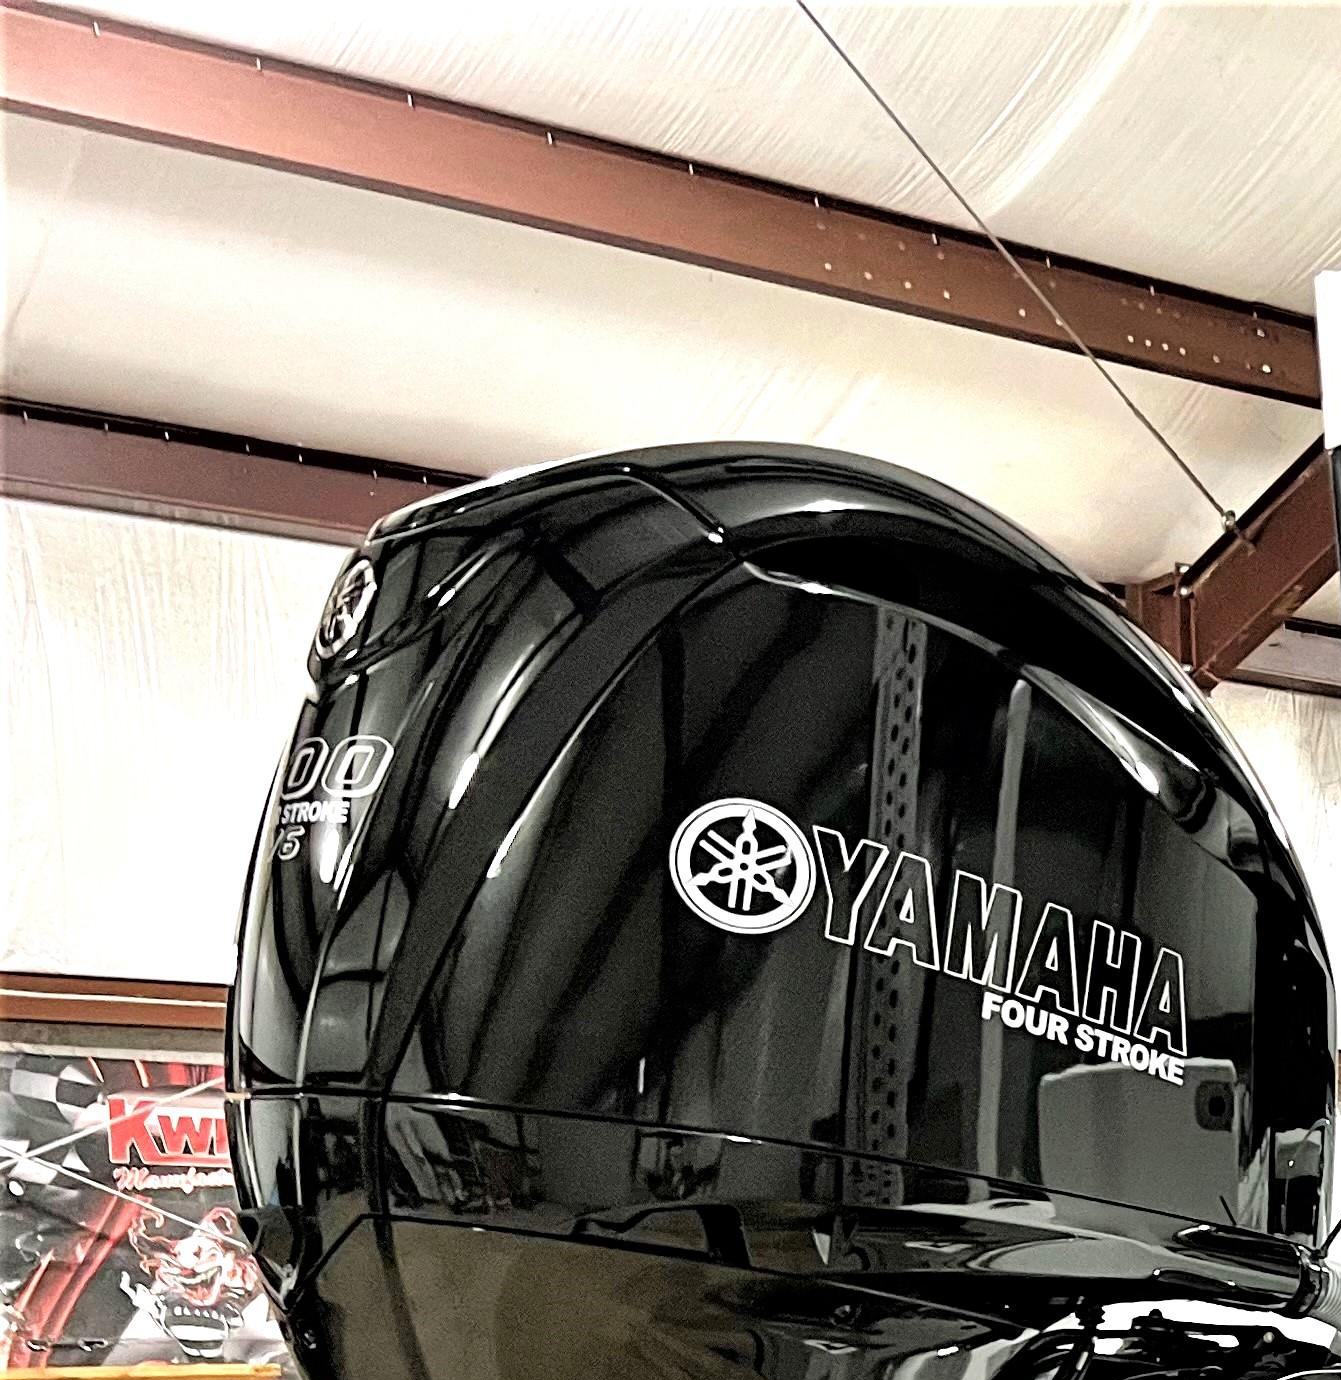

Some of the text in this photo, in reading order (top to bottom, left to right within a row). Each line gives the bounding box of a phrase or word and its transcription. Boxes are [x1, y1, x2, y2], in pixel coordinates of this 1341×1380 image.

[280, 734, 395, 799] 00
[281, 800, 350, 824] STROKE
[812, 825, 1188, 1057] YAMAHA
[981, 991, 1186, 1087] FOUR STROKE
